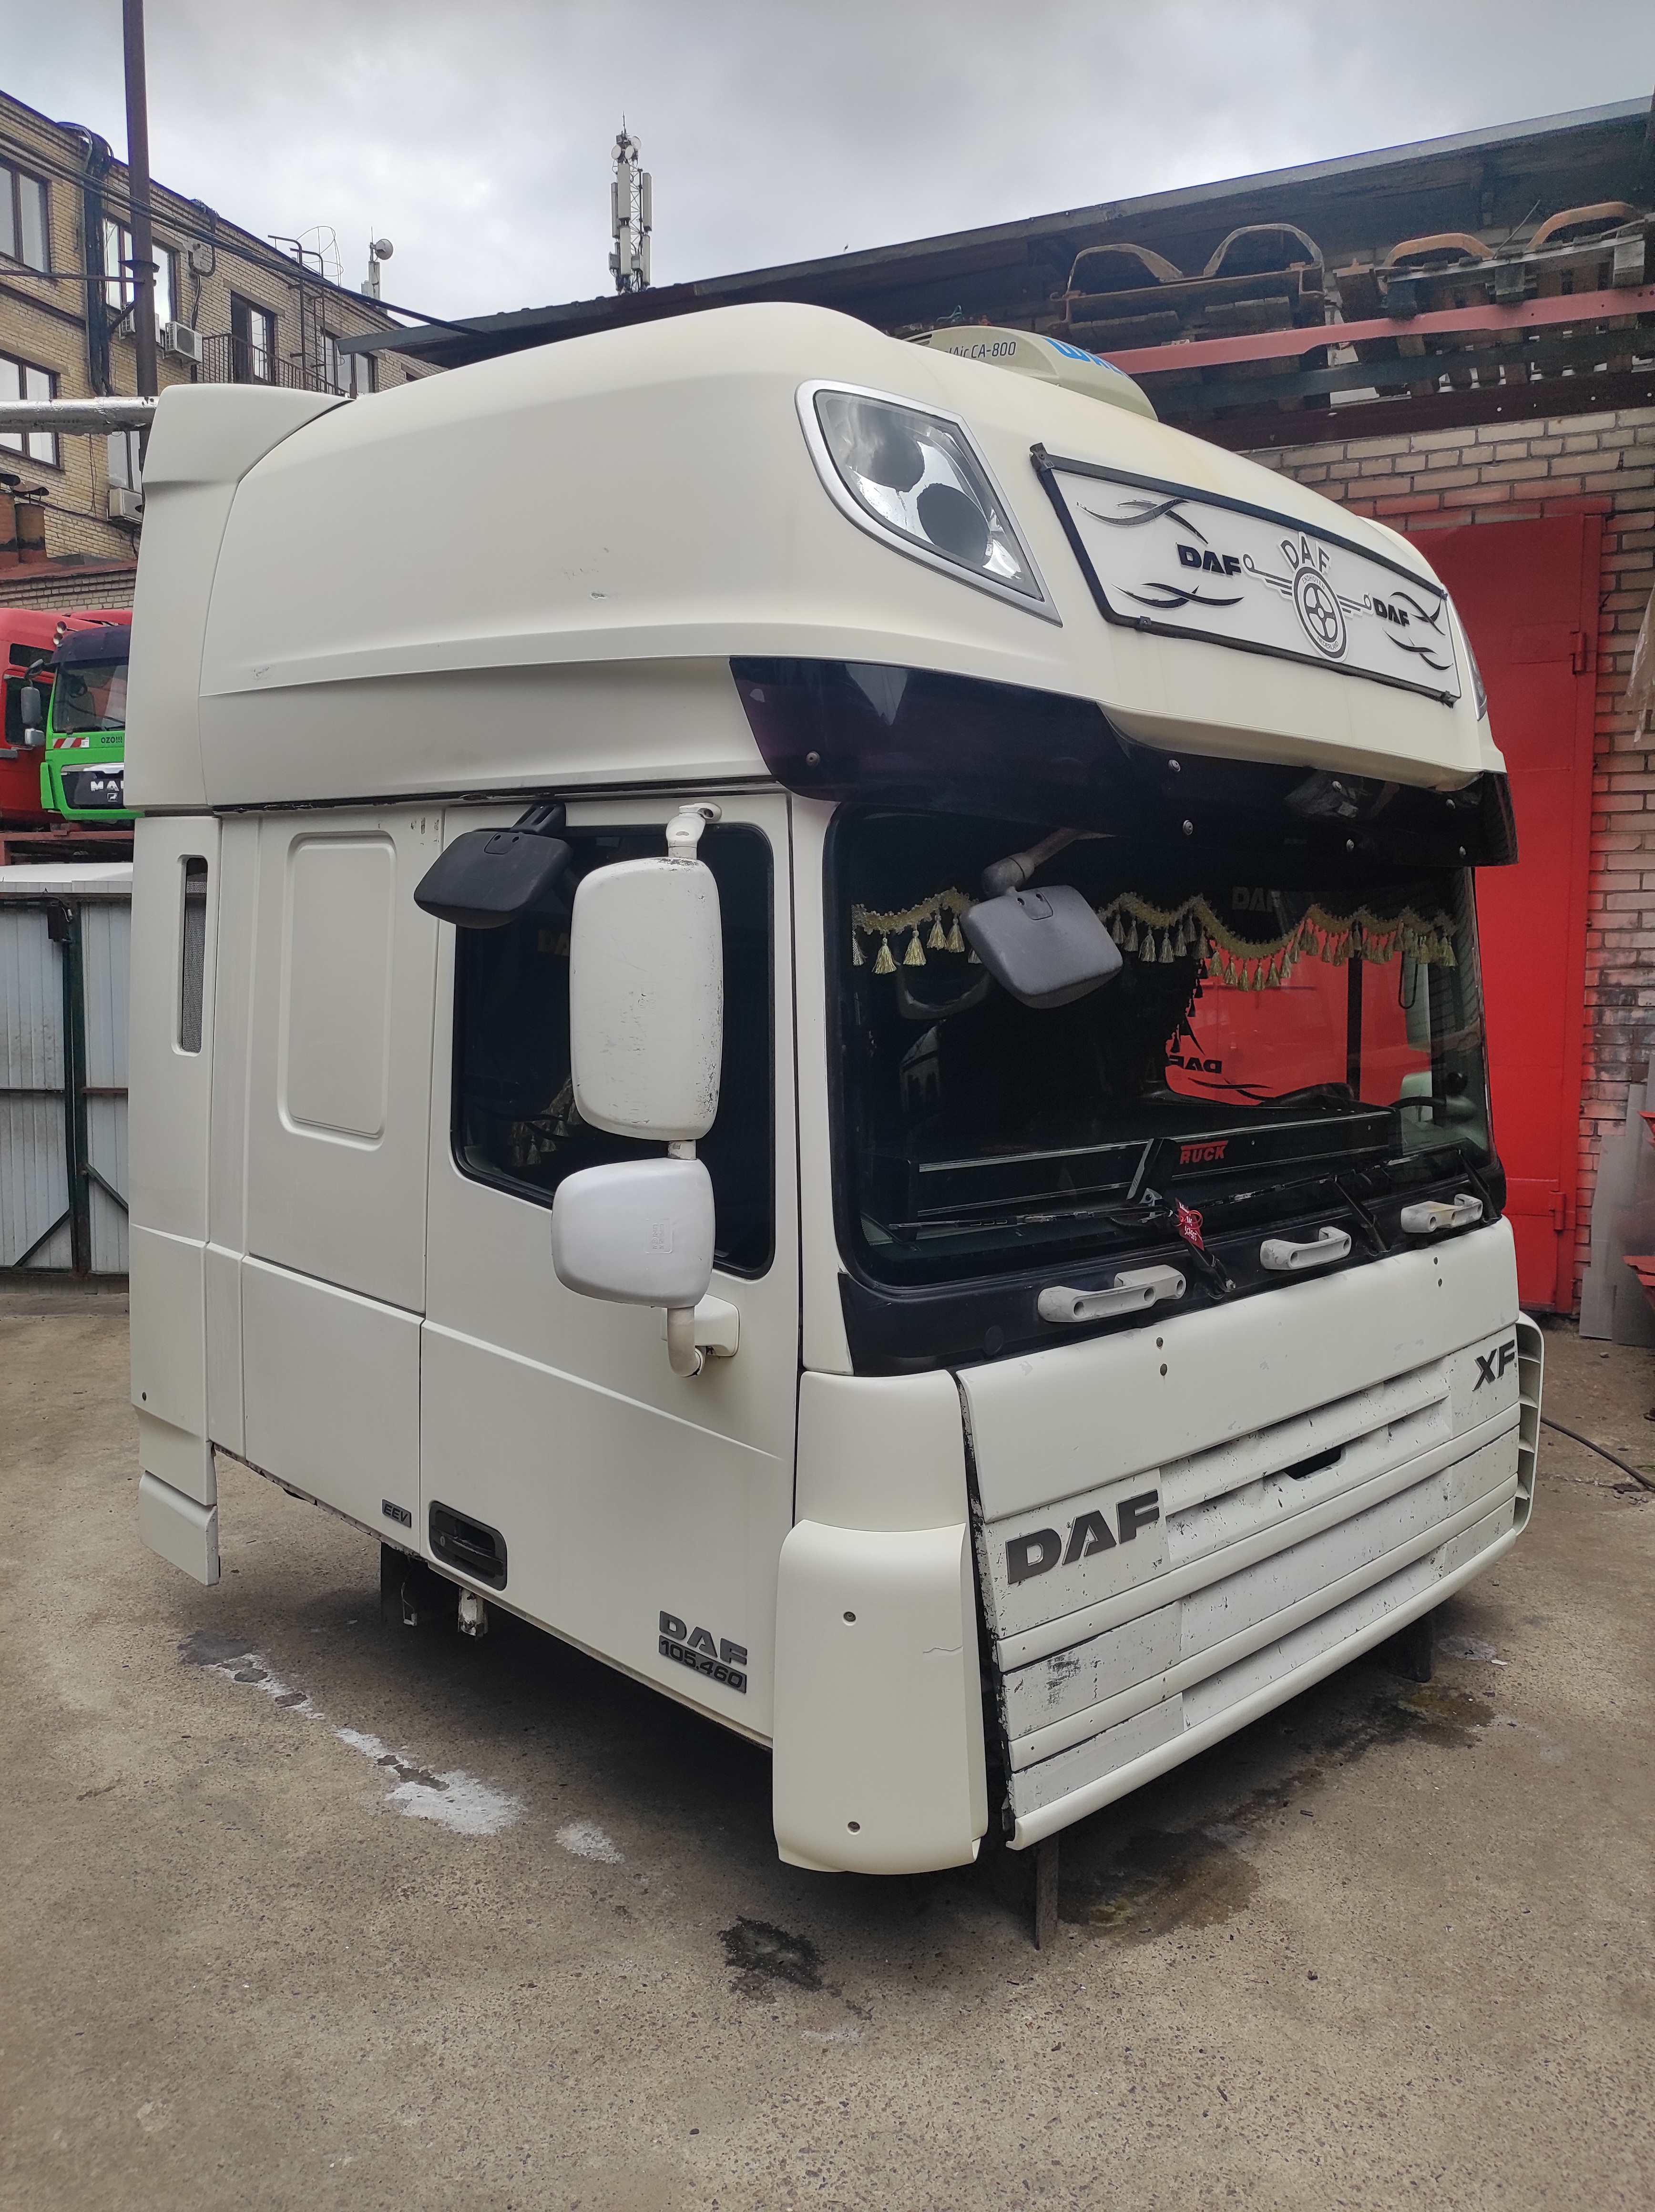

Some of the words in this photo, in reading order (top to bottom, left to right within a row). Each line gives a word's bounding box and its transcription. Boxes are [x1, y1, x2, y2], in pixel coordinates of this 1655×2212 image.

[971, 341, 1016, 358] CA-800
[1176, 543, 1242, 576] DAF
[1280, 536, 1330, 573] DAF
[1372, 596, 1410, 627] DAF
[1472, 1339, 1516, 1392] XF
[384, 1504, 409, 1522] EEV
[1005, 1488, 1160, 1585] DAF
[659, 1610, 747, 1666] DAF
[661, 1640, 743, 1688] 105.460
